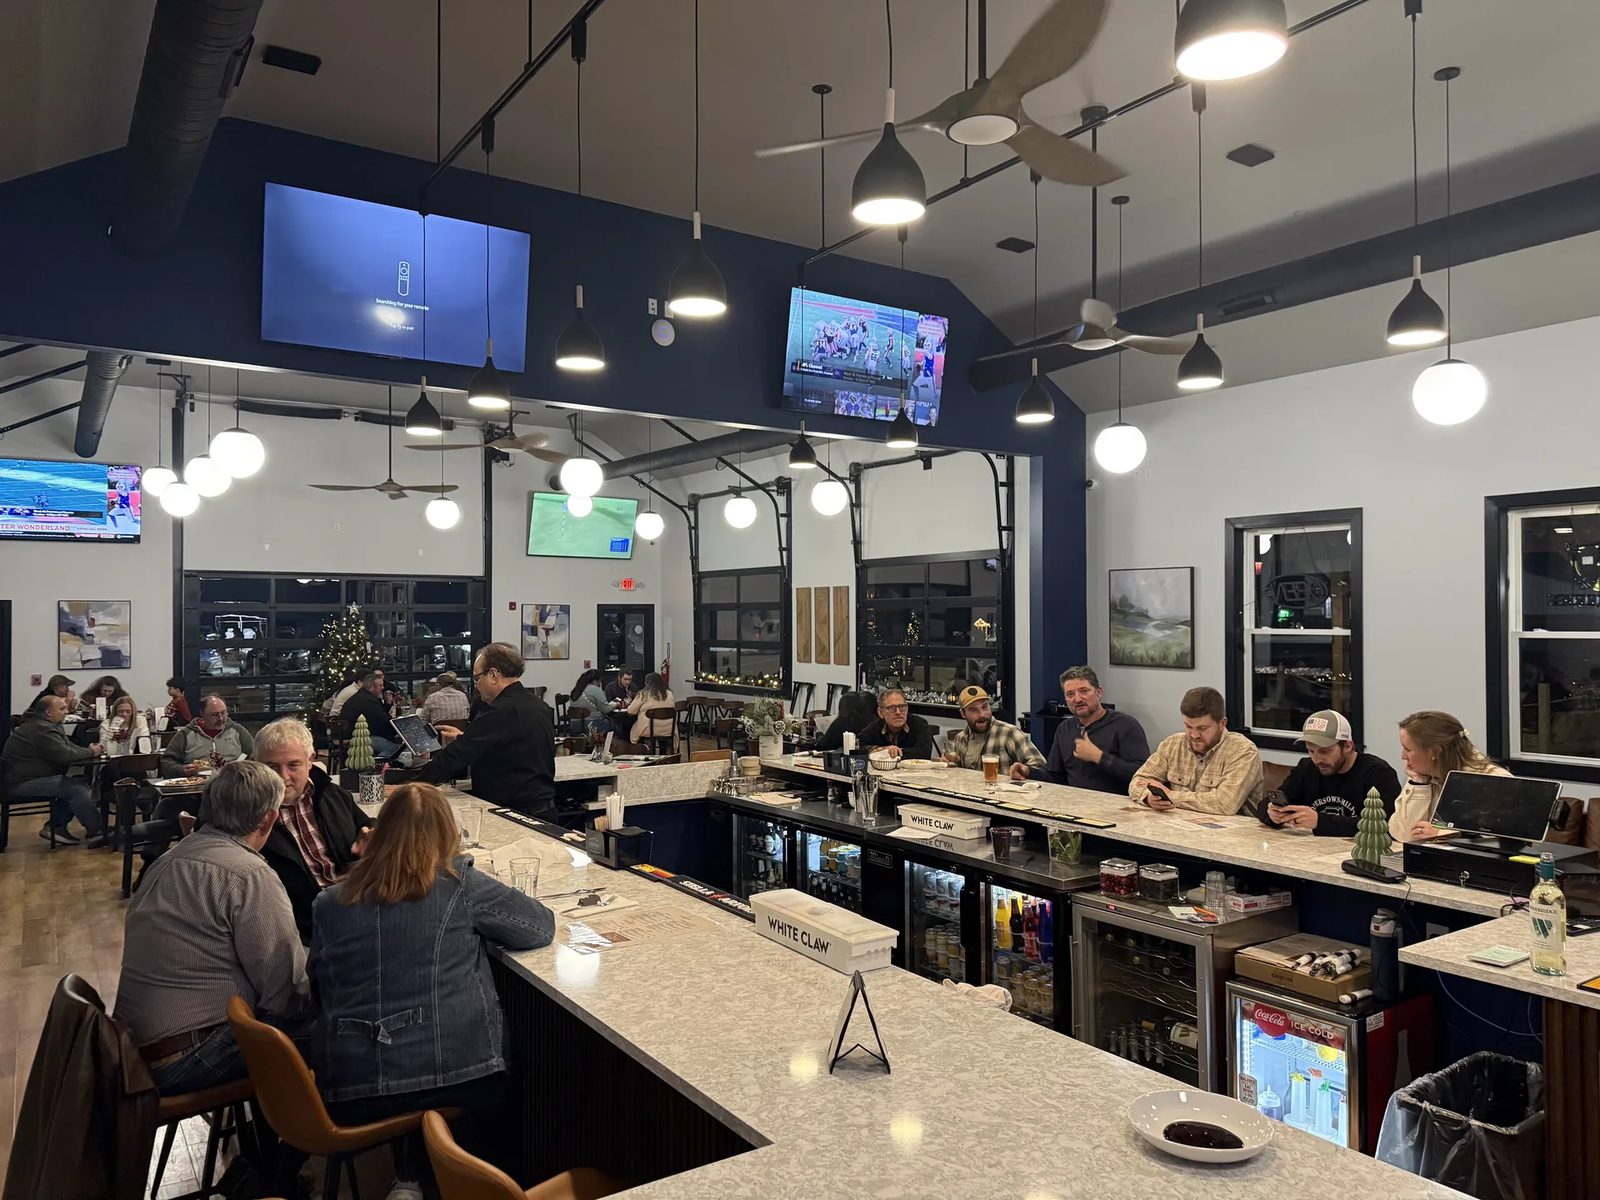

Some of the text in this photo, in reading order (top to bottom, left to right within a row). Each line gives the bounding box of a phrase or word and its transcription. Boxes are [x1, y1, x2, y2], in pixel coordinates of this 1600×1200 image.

[375, 298, 397, 307] Searching
[910, 814, 954, 831] WHITE CLAW
[767, 915, 830, 955] WHITE CLAW
[1291, 1021, 1306, 1032] ICE
[1308, 1026, 1334, 1040] COLD
